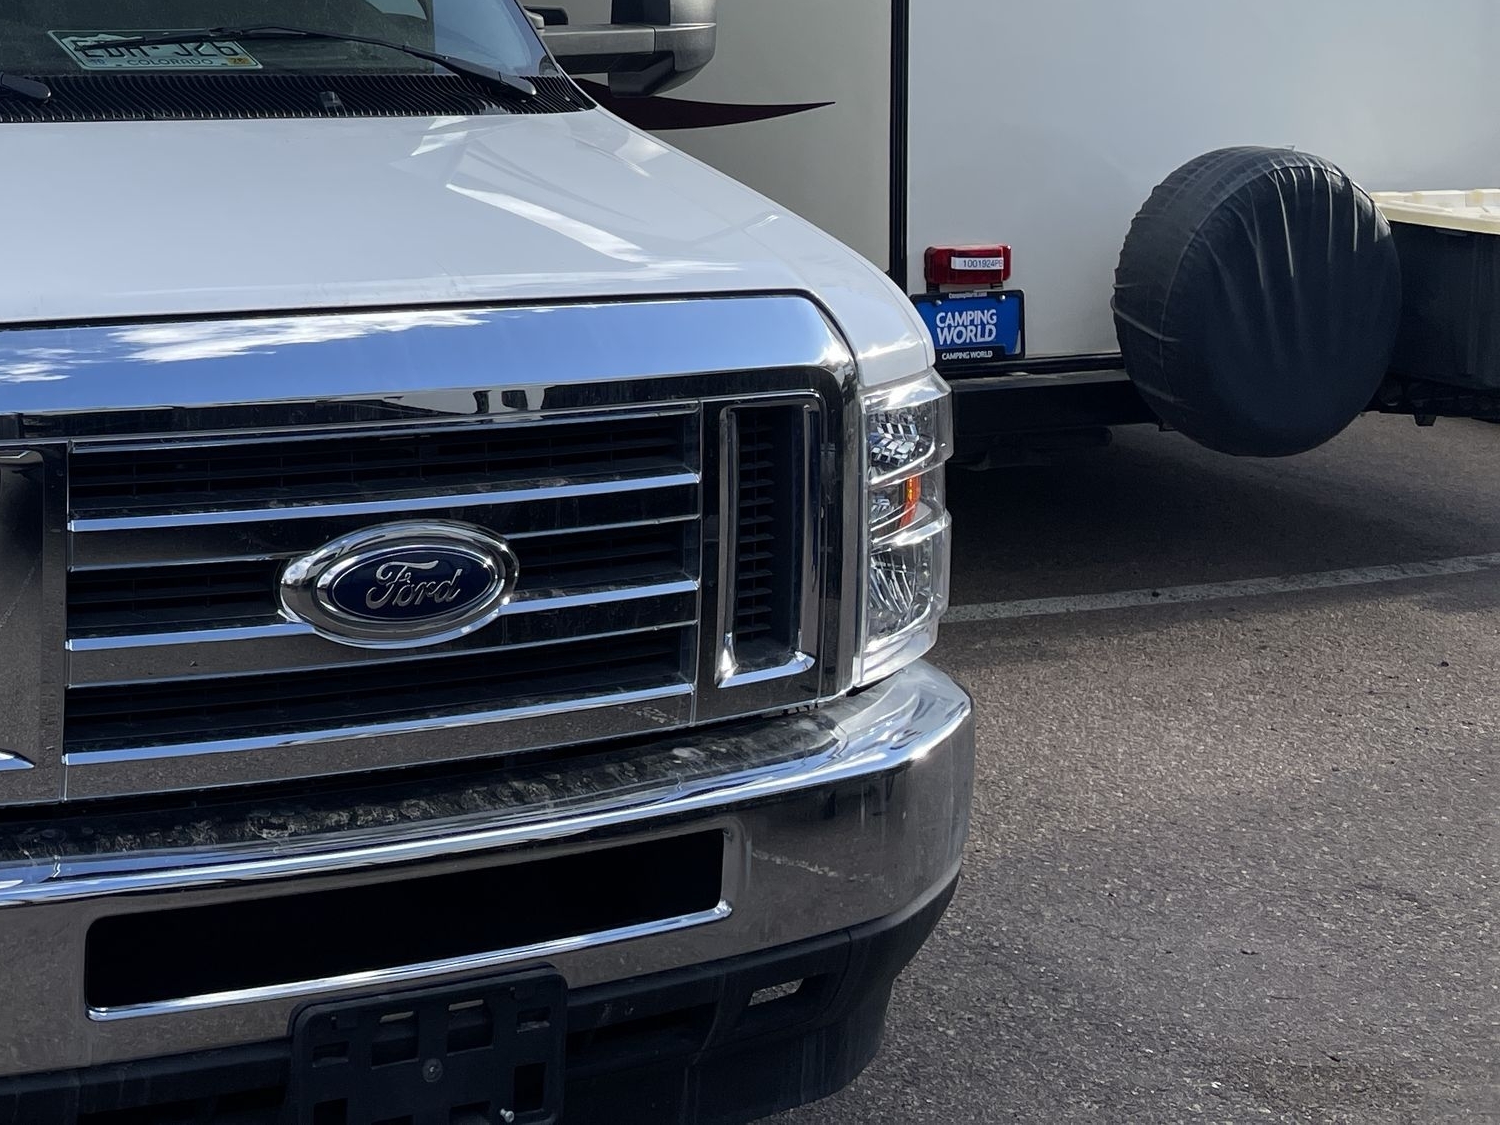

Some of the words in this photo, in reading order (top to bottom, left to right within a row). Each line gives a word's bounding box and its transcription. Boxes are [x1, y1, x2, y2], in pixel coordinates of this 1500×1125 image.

[127, 58, 214, 66] COLORADO
[936, 309, 997, 328] CAMPING
[937, 324, 997, 346] WORLD
[942, 351, 969, 361] CAMPING
[970, 350, 993, 359] WORLD
[365, 559, 463, 610] Ford
